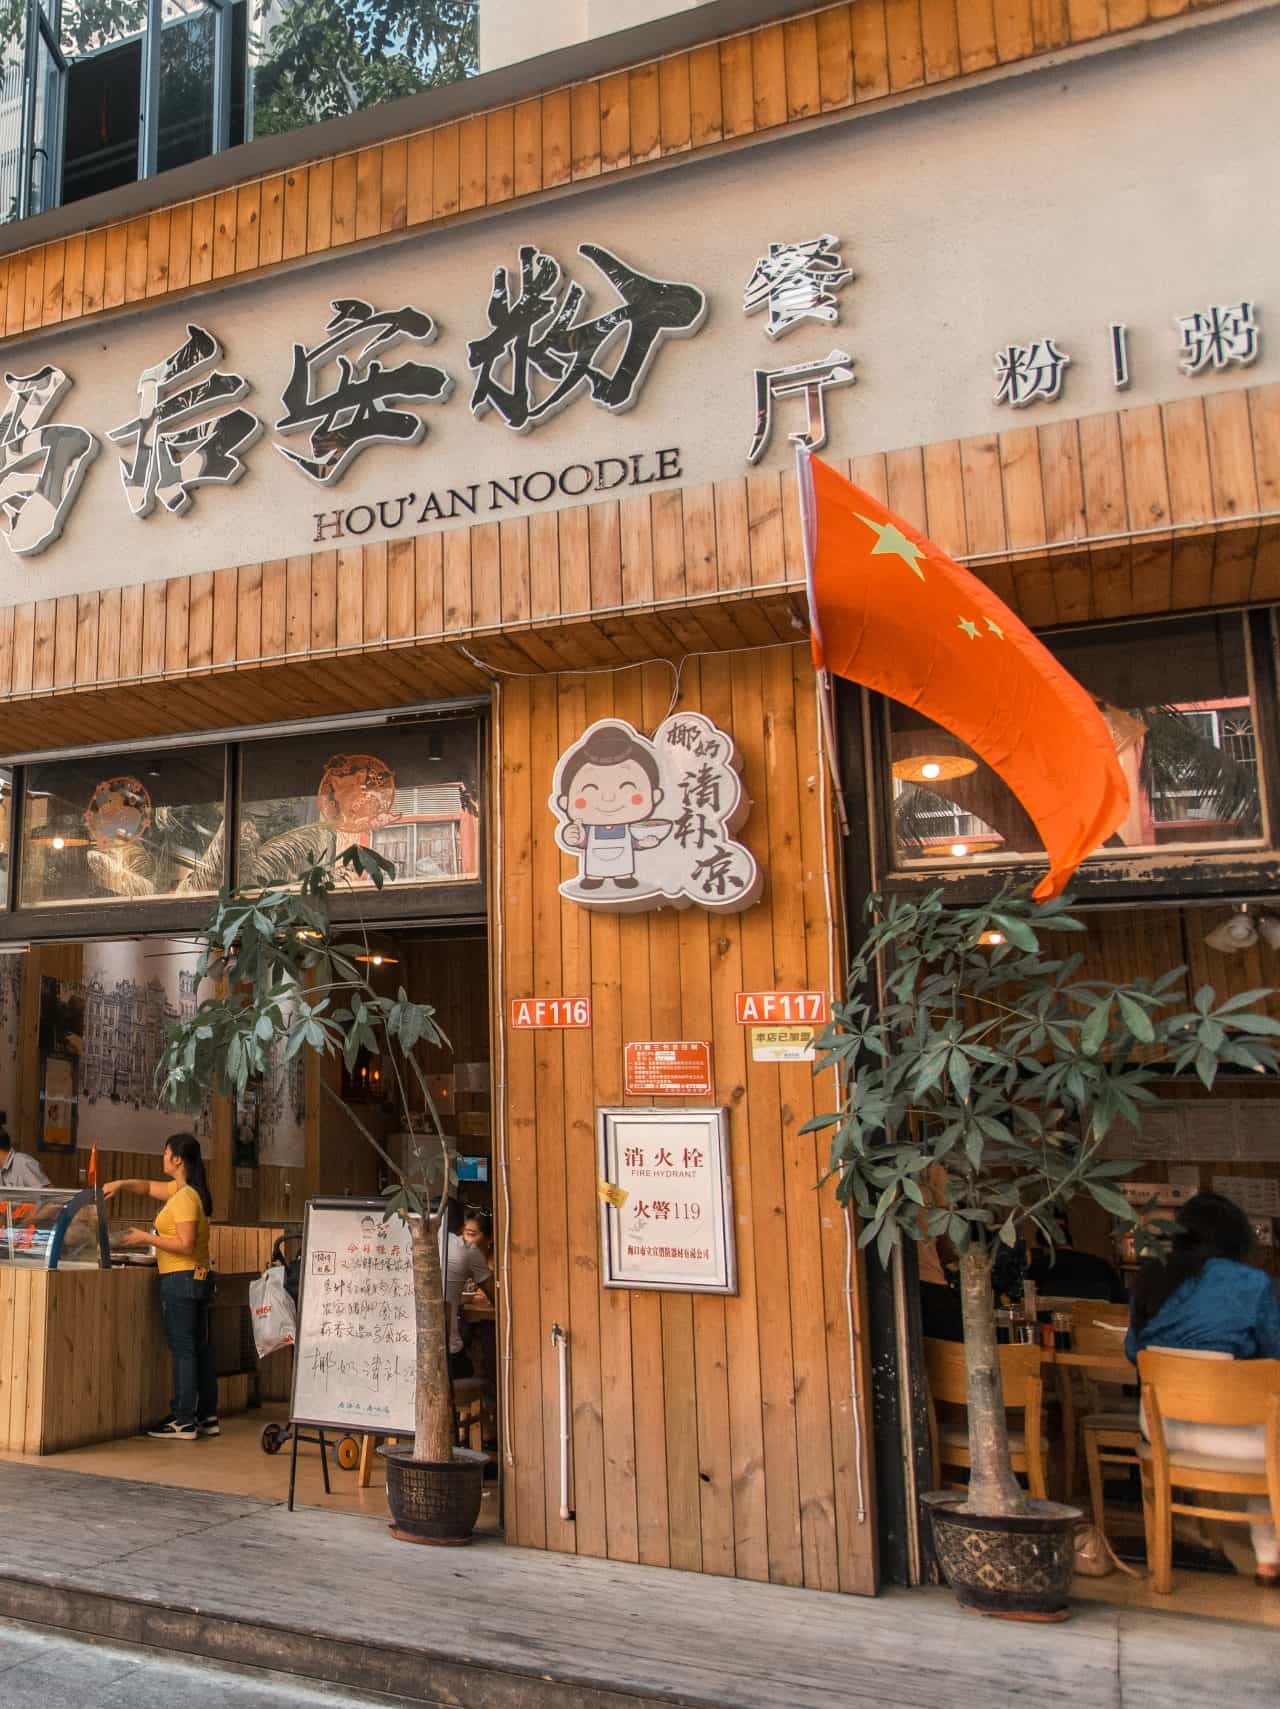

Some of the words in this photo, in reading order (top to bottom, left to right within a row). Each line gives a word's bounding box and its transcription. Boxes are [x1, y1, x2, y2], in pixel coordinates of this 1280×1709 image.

[744, 233, 855, 465] 餐厅
[995, 337, 1070, 408] 粉
[1181, 300, 1261, 374] 粥
[489, 447, 684, 509] NOODLE
[517, 1001, 587, 1025] AF116
[742, 994, 821, 1020] AF117
[624, 1148, 704, 1168] 消火栓
[631, 1168, 651, 1177] FIRE
[653, 1170, 696, 1179] HYDRANT
[634, 1200, 701, 1220] 火警119
